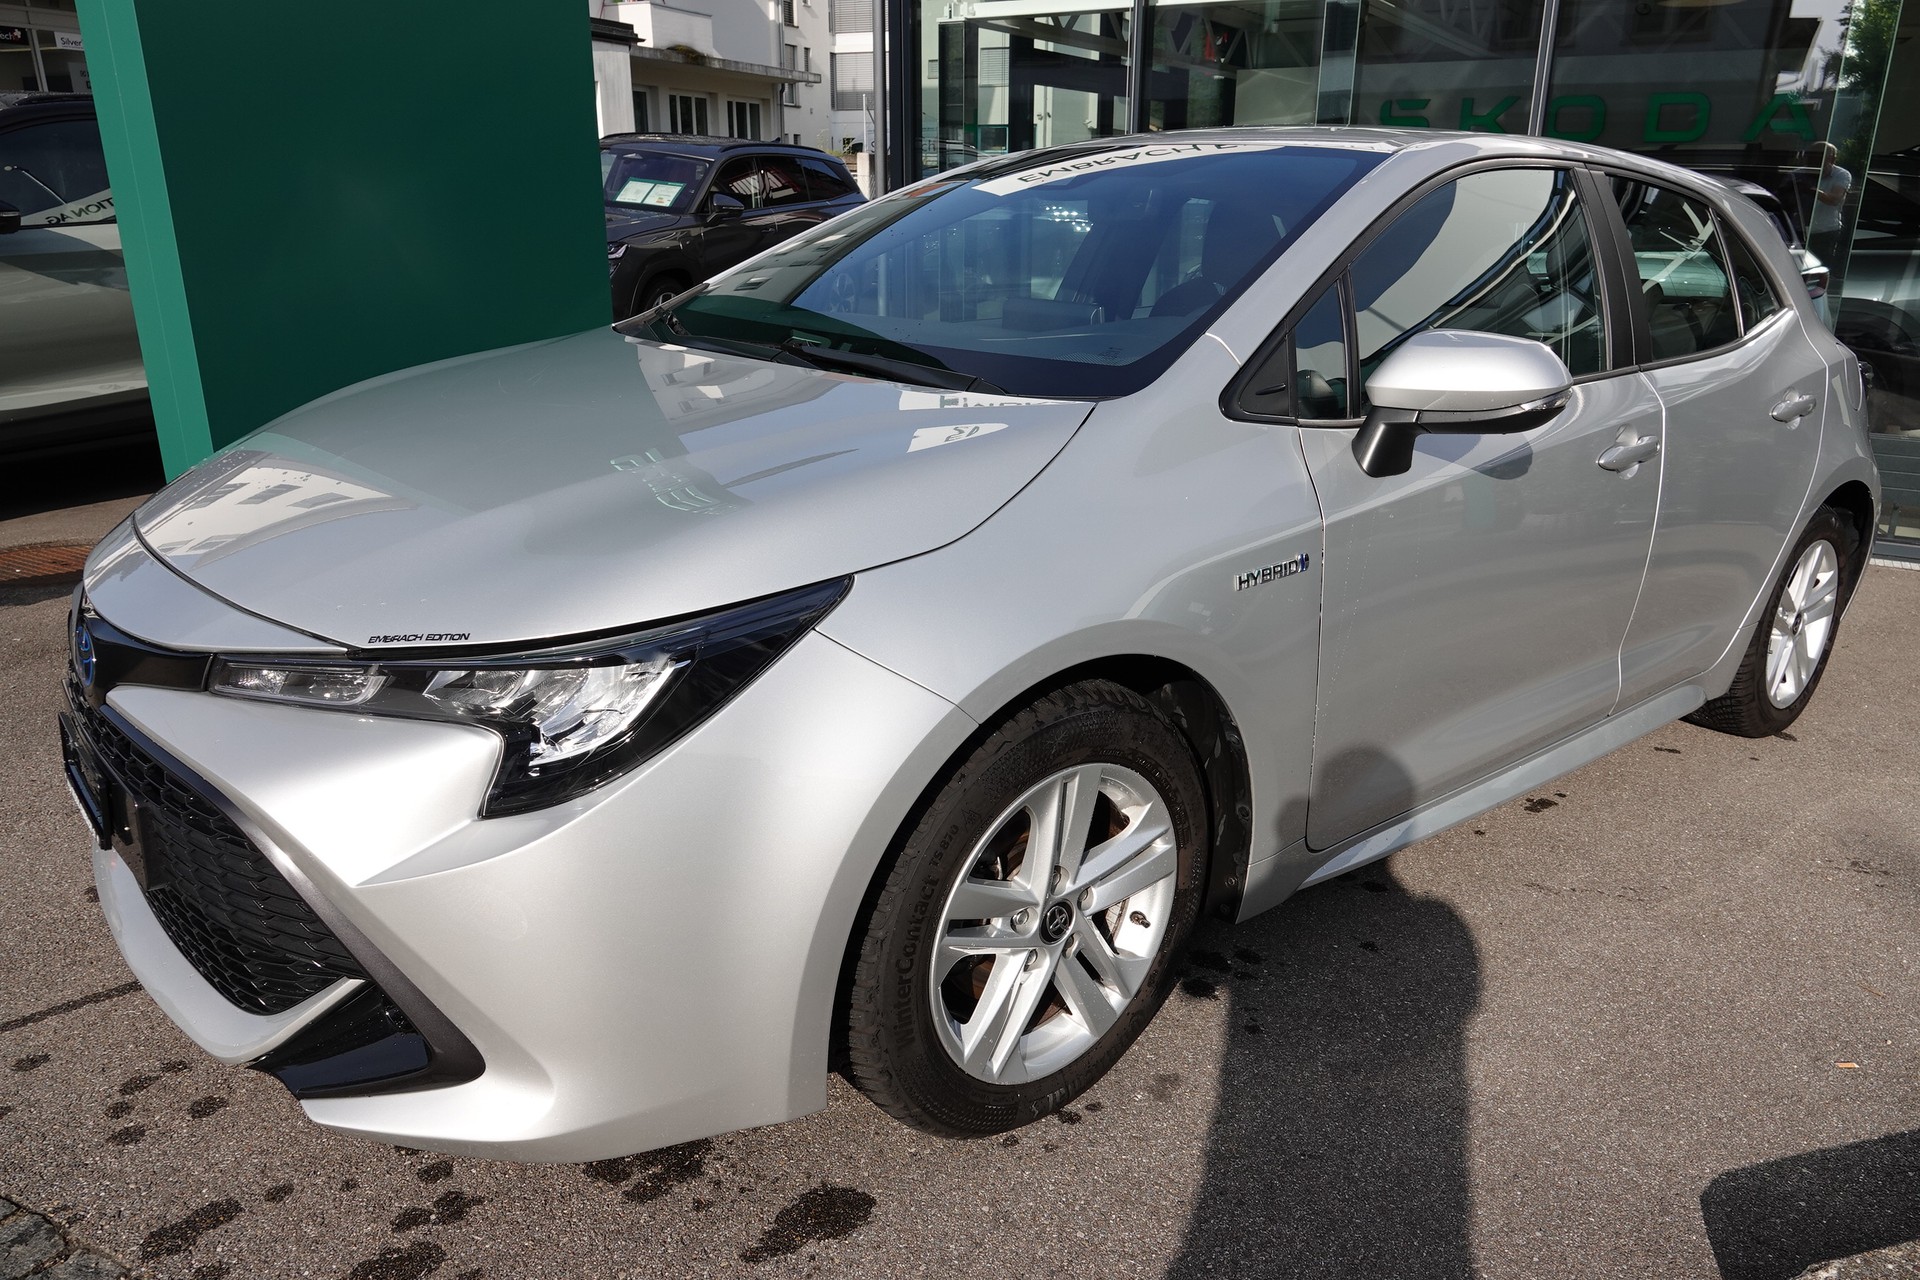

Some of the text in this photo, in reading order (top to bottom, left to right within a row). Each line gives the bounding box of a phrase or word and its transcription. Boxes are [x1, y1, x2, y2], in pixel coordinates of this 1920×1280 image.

[1234, 559, 1299, 591] HYBRID
[368, 632, 471, 644] EMBRACH EDITION
[894, 872, 940, 1051] WinterContact
